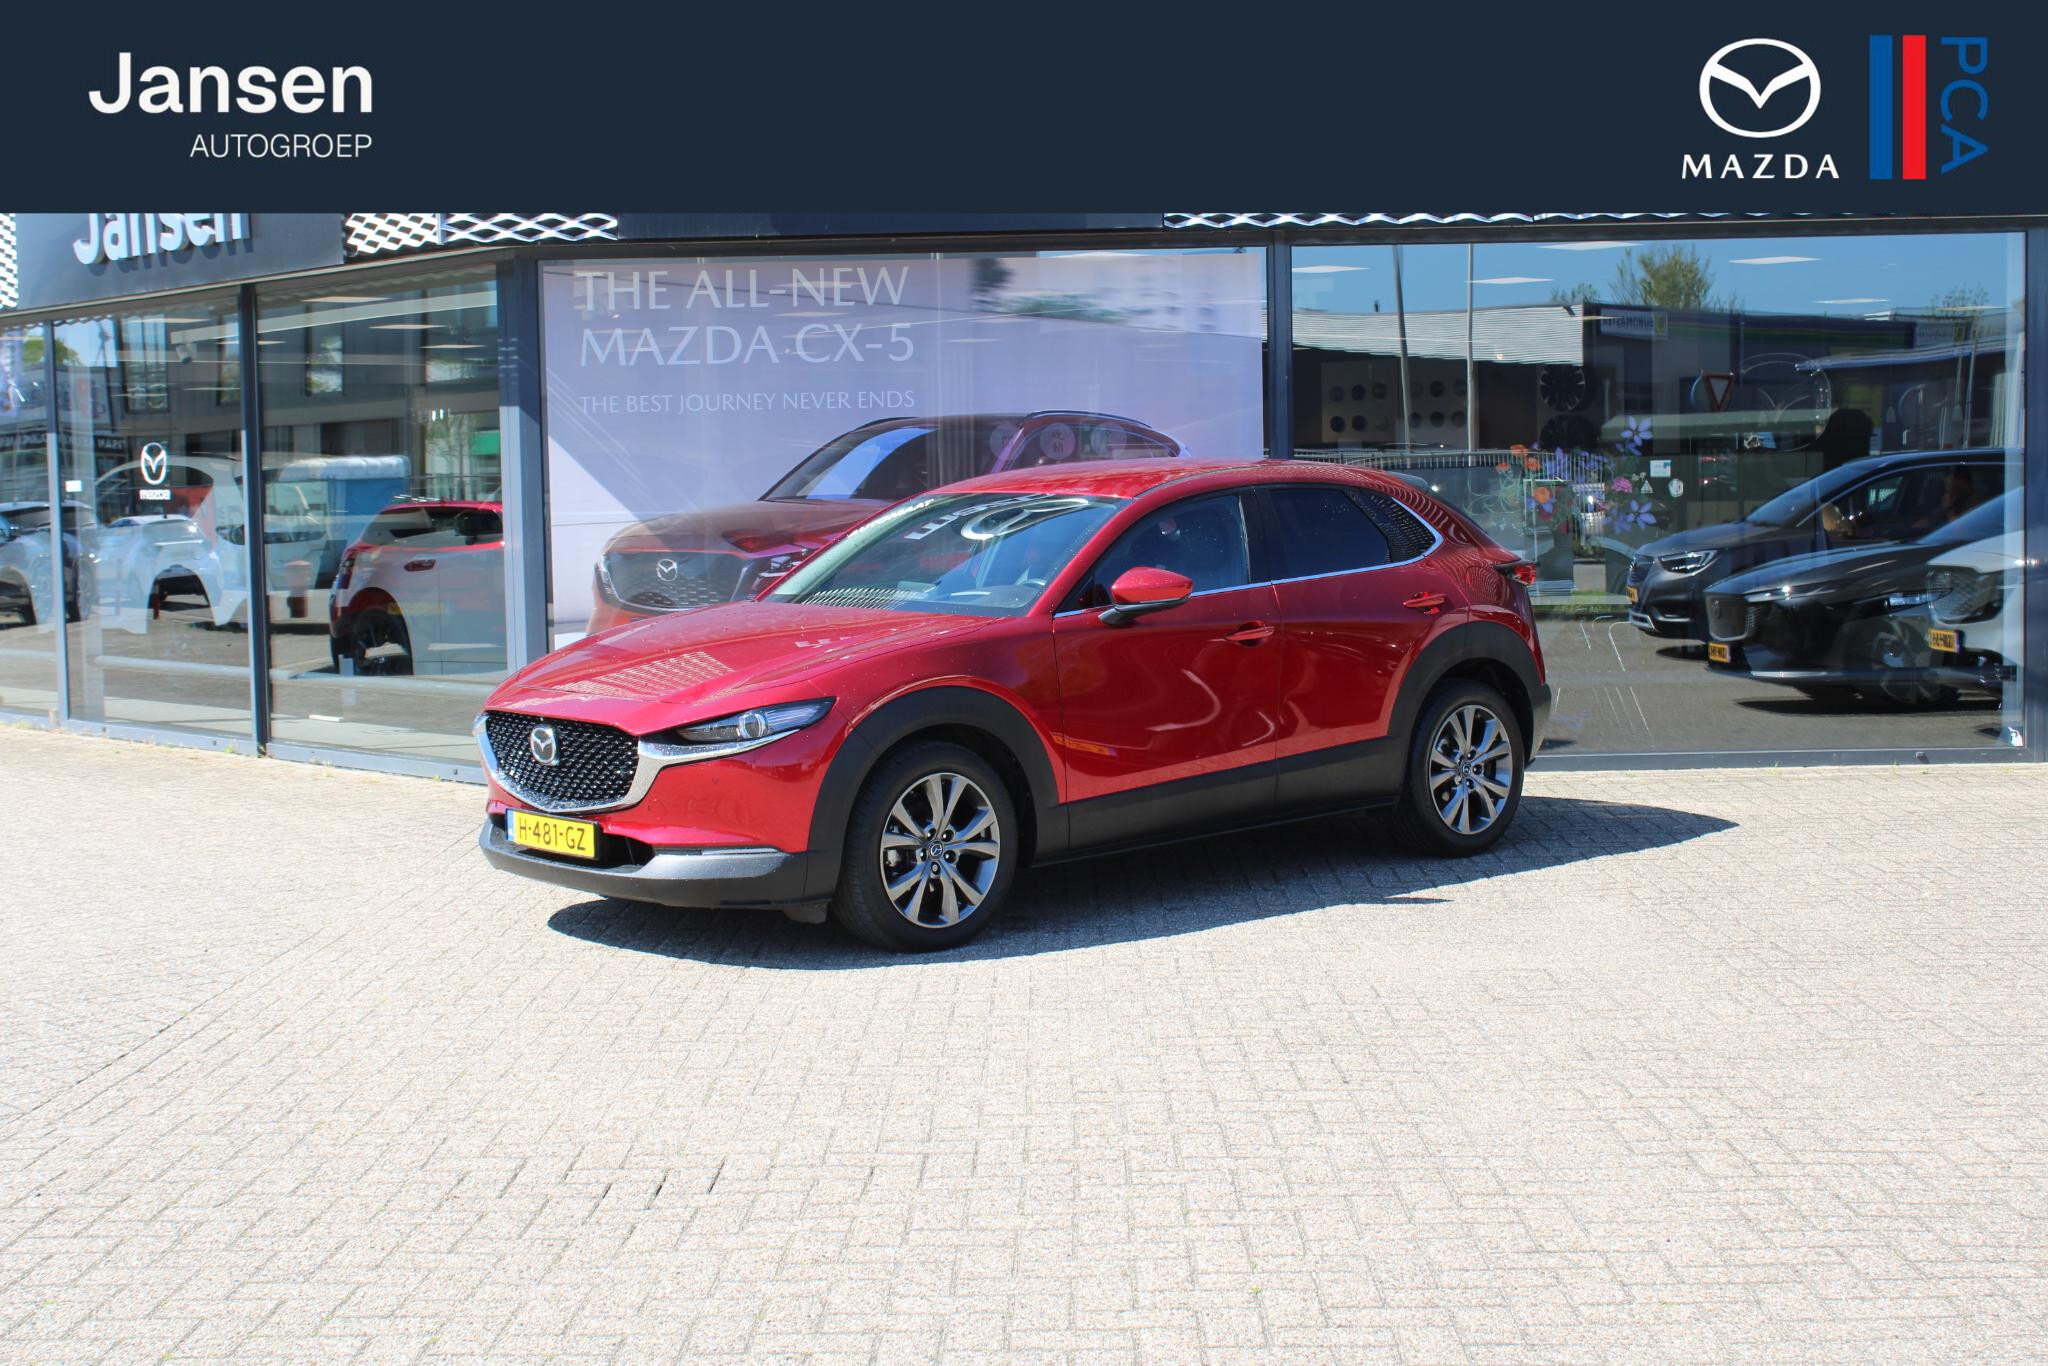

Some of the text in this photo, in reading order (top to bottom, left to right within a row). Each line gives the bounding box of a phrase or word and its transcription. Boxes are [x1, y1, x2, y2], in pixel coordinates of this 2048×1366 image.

[574, 266, 910, 311] THE ALL-NEW
[580, 322, 915, 367] MAZDA CX-5
[580, 390, 915, 415] THE BEST JOURNEY NEVER ENDS
